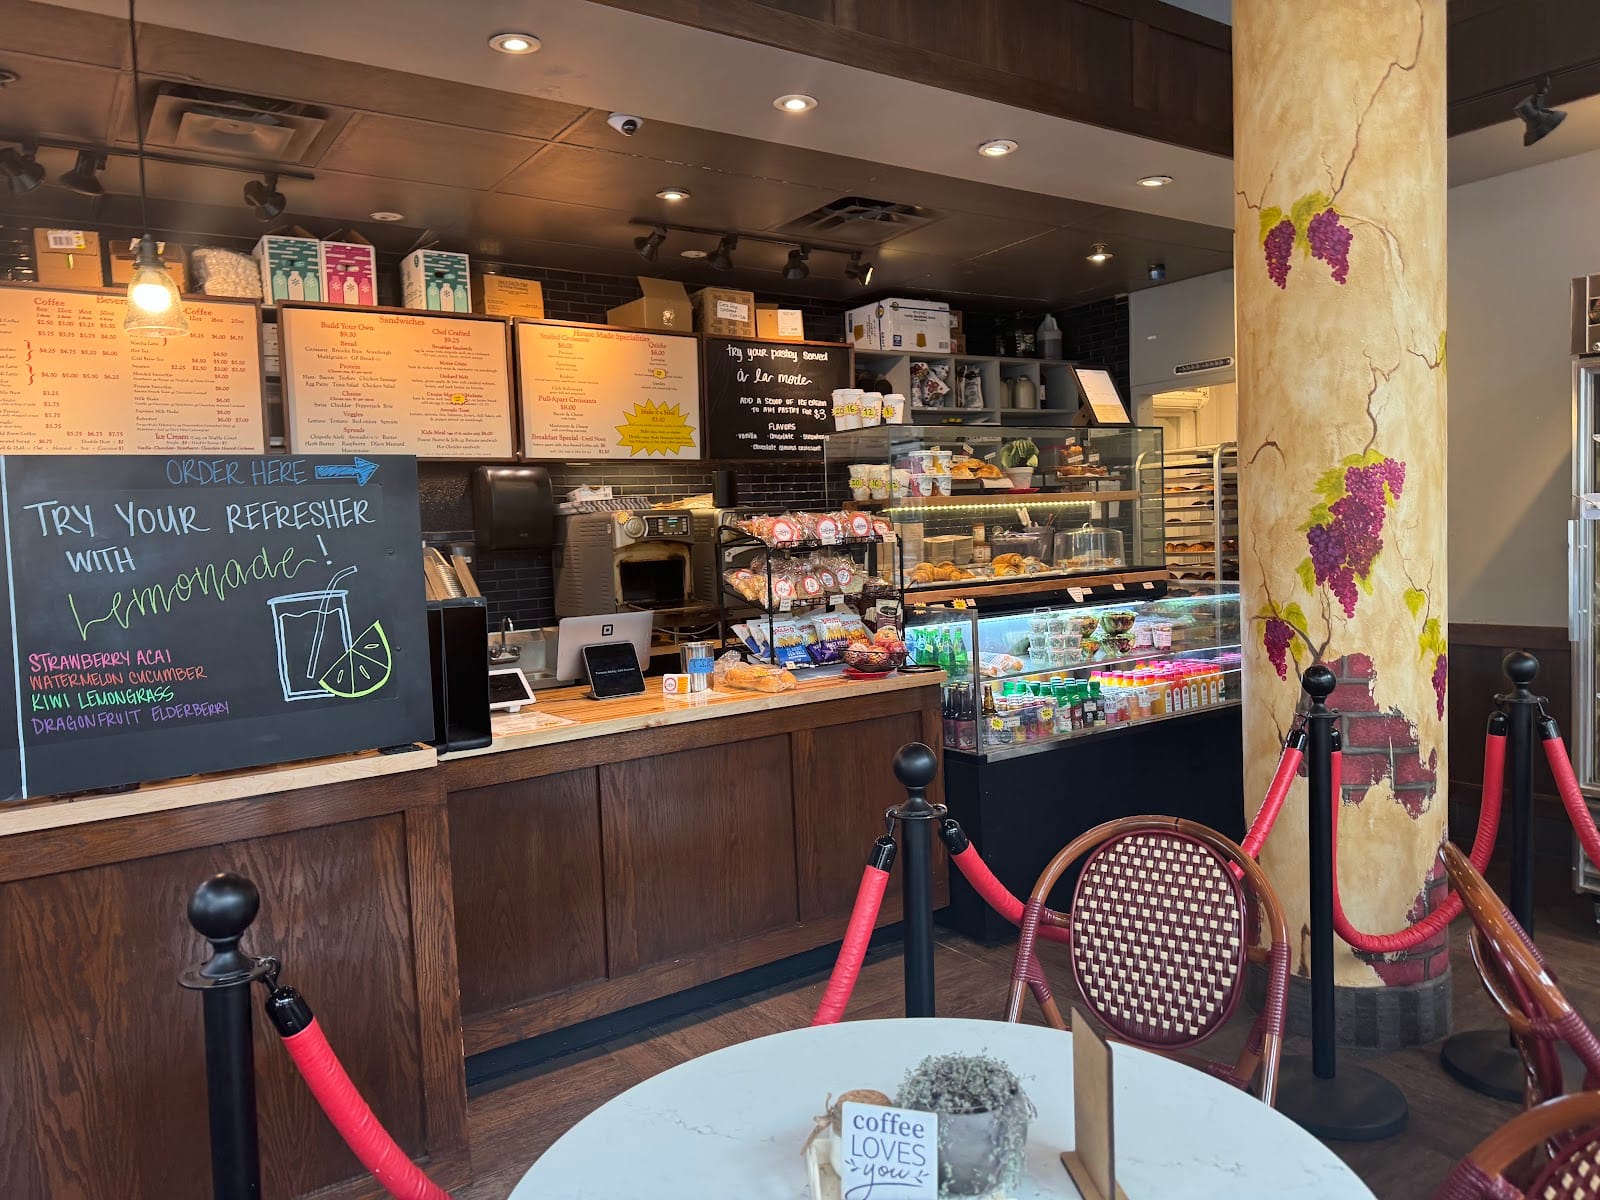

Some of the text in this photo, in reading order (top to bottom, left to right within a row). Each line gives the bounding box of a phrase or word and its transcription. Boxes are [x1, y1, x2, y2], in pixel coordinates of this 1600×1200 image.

[34, 297, 65, 307] Coffee
[320, 321, 339, 329] Build
[340, 322, 357, 330] Your
[379, 316, 425, 326] Sandwiches
[777, 374, 813, 386] mode
[740, 397, 753, 405] ADD
[764, 397, 783, 405] SCOOP
[768, 423, 796, 431] FLAVORS
[814, 409, 826, 420] $3
[531, 433, 558, 441] Breakfast
[559, 434, 578, 442] Special
[166, 459, 307, 486] ORDER HERE
[23, 498, 376, 538] TRY YOUR REFRESHER
[64, 546, 137, 573] WITH
[27, 648, 172, 674] STRAWBERRY ACAI
[28, 665, 208, 691] WATERMELON CUCUMBER
[31, 686, 175, 712] KIWI LEMONGRASS
[31, 701, 231, 736] DRAGONFRUIT ELDERBERRY
[852, 1112, 925, 1139] coffee
[850, 1134, 927, 1167] LOVES
